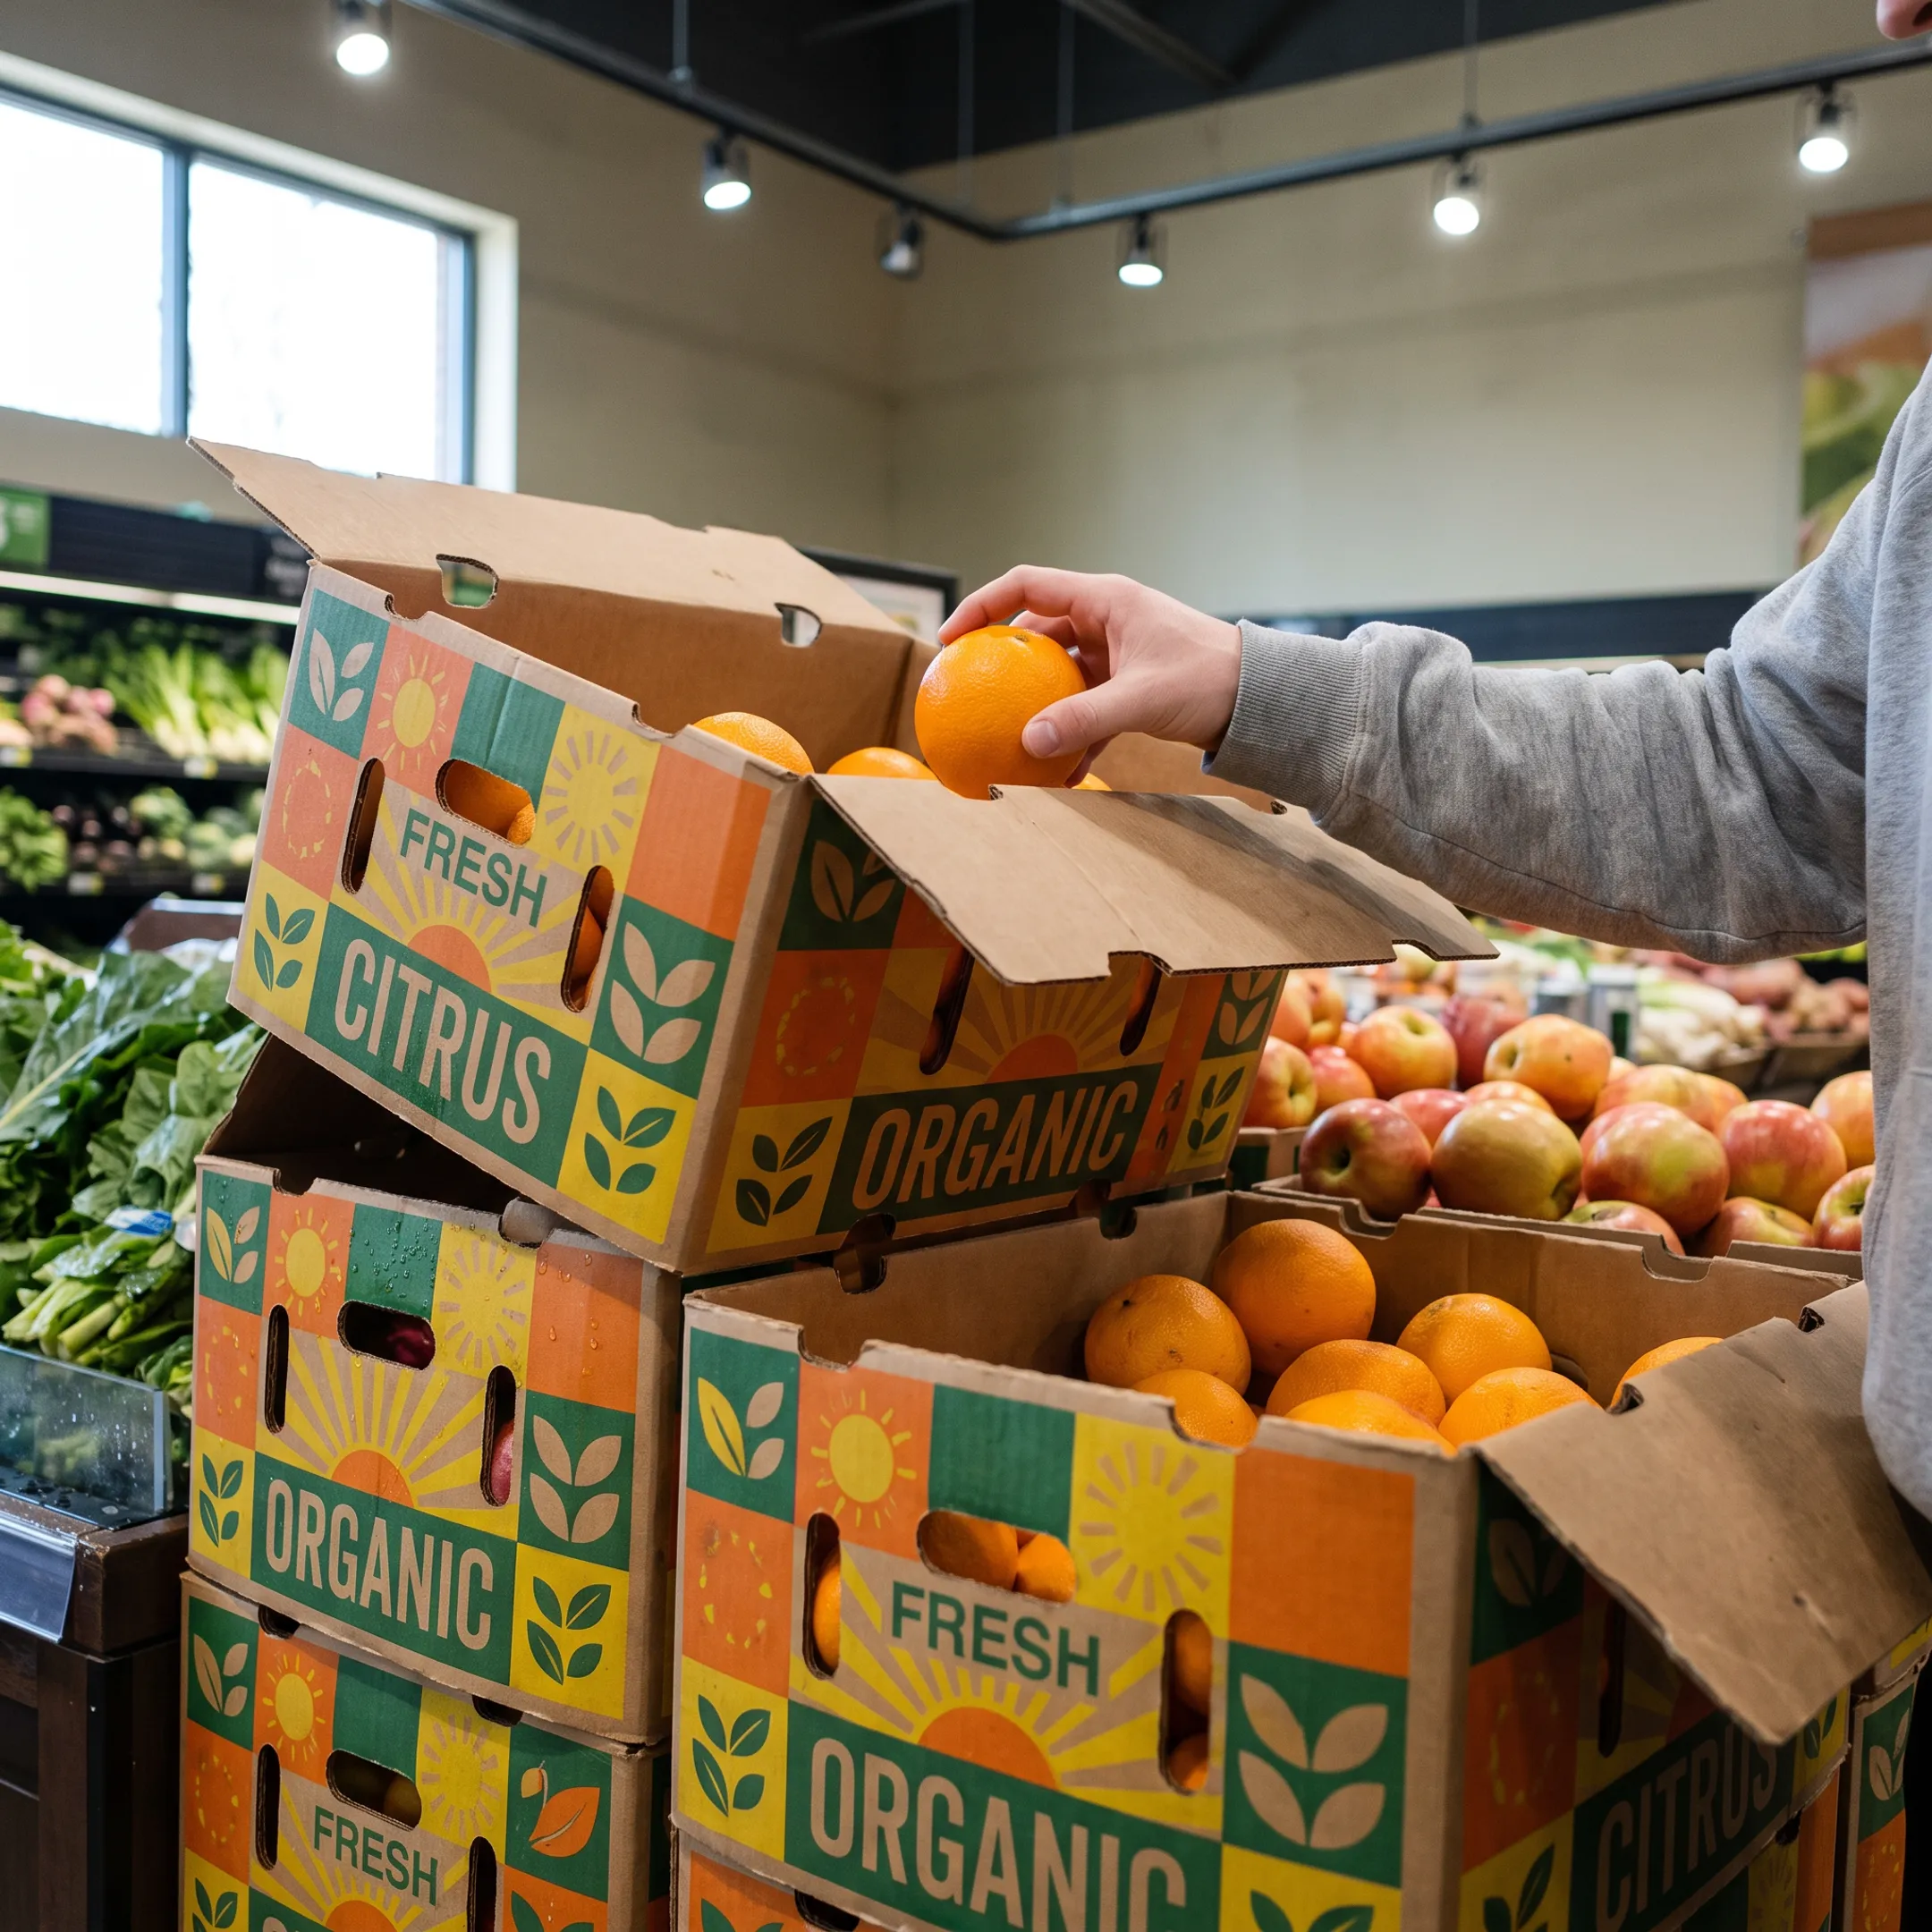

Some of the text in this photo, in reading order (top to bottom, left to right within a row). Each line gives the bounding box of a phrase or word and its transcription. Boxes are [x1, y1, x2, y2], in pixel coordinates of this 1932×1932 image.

[399, 807, 548, 928] FRESH
[334, 938, 552, 1146] CITRUS
[851, 1080, 1139, 1211] ORGANIC
[265, 1479, 495, 1651] ORGANIC
[891, 1580, 1100, 1698] FRESH
[313, 1804, 438, 1907] FRESH
[809, 1737, 1187, 1932] ORGANIC
[1596, 1723, 1777, 1932] CITRUS
